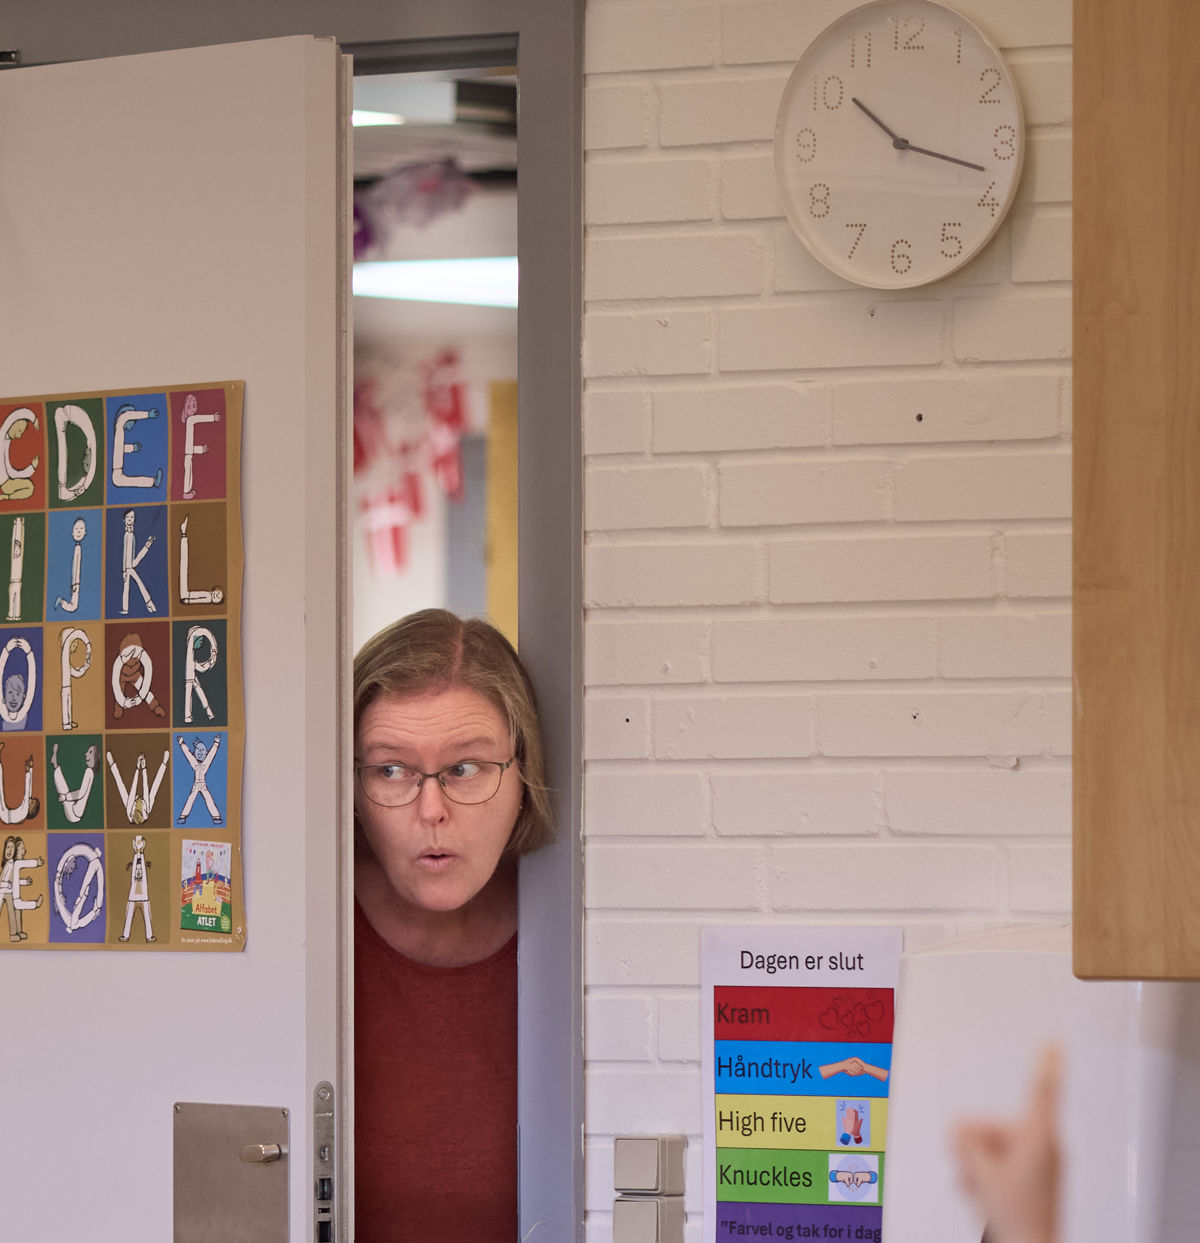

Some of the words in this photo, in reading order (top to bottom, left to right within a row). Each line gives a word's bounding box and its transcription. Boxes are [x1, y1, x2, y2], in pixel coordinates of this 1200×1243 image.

[891, 14, 925, 50] 12
[955, 28, 962, 64] 1
[850, 32, 871, 68] 11
[811, 75, 844, 111] 10
[979, 68, 1002, 104] 2
[796, 128, 816, 162] 9
[994, 125, 1015, 160] 3
[809, 183, 830, 218] 8
[977, 181, 999, 217] 4
[846, 224, 867, 259] 7
[891, 239, 911, 274] 6
[941, 223, 962, 258] 5
[55, 405, 97, 501] D
[112, 404, 163, 488] E
[181, 394, 221, 500] F
[8, 517, 24, 622] I
[54, 517, 87, 613] J
[120, 510, 157, 615] K
[179, 514, 224, 605] L
[60, 627, 93, 731] P
[112, 633, 167, 719] Q
[185, 626, 218, 724] R
[51, 743, 99, 824] V
[106, 750, 169, 825] W
[177, 734, 223, 825] X
[54, 842, 104, 934] Ø
[196, 916, 216, 927] ATLET
[740, 951, 799, 974] Dagen
[805, 955, 822, 970] er
[829, 952, 864, 970] slut
[717, 1003, 770, 1024] Kram
[717, 1055, 813, 1083] Håndtryk
[719, 1111, 765, 1136] High
[770, 1112, 806, 1133] five
[719, 1165, 813, 1187] Knuckles
[776, 1225, 793, 1240] og
[797, 1223, 820, 1238] tak
[823, 1224, 844, 1239] for
[847, 1224, 851, 1239] i
[855, 1225, 881, 1243] dag
